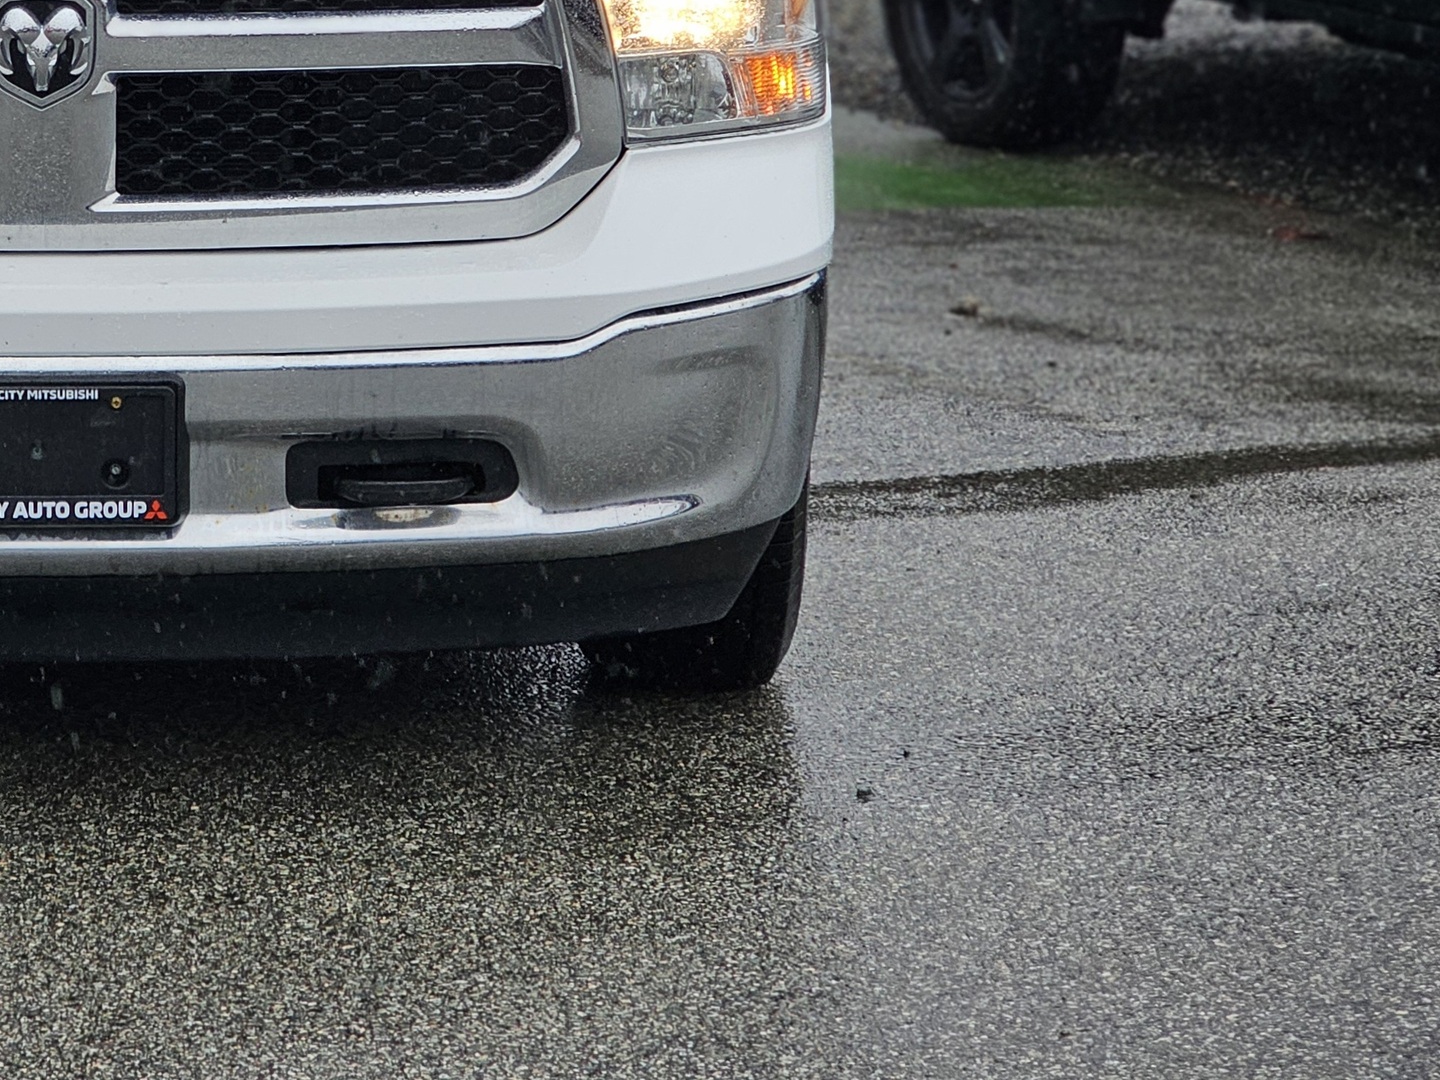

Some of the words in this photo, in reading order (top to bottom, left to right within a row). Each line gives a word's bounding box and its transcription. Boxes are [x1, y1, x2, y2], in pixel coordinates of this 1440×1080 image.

[27, 389, 99, 400] MITSUBISHI
[13, 501, 69, 519] AUTO
[74, 501, 147, 519] GROUP
